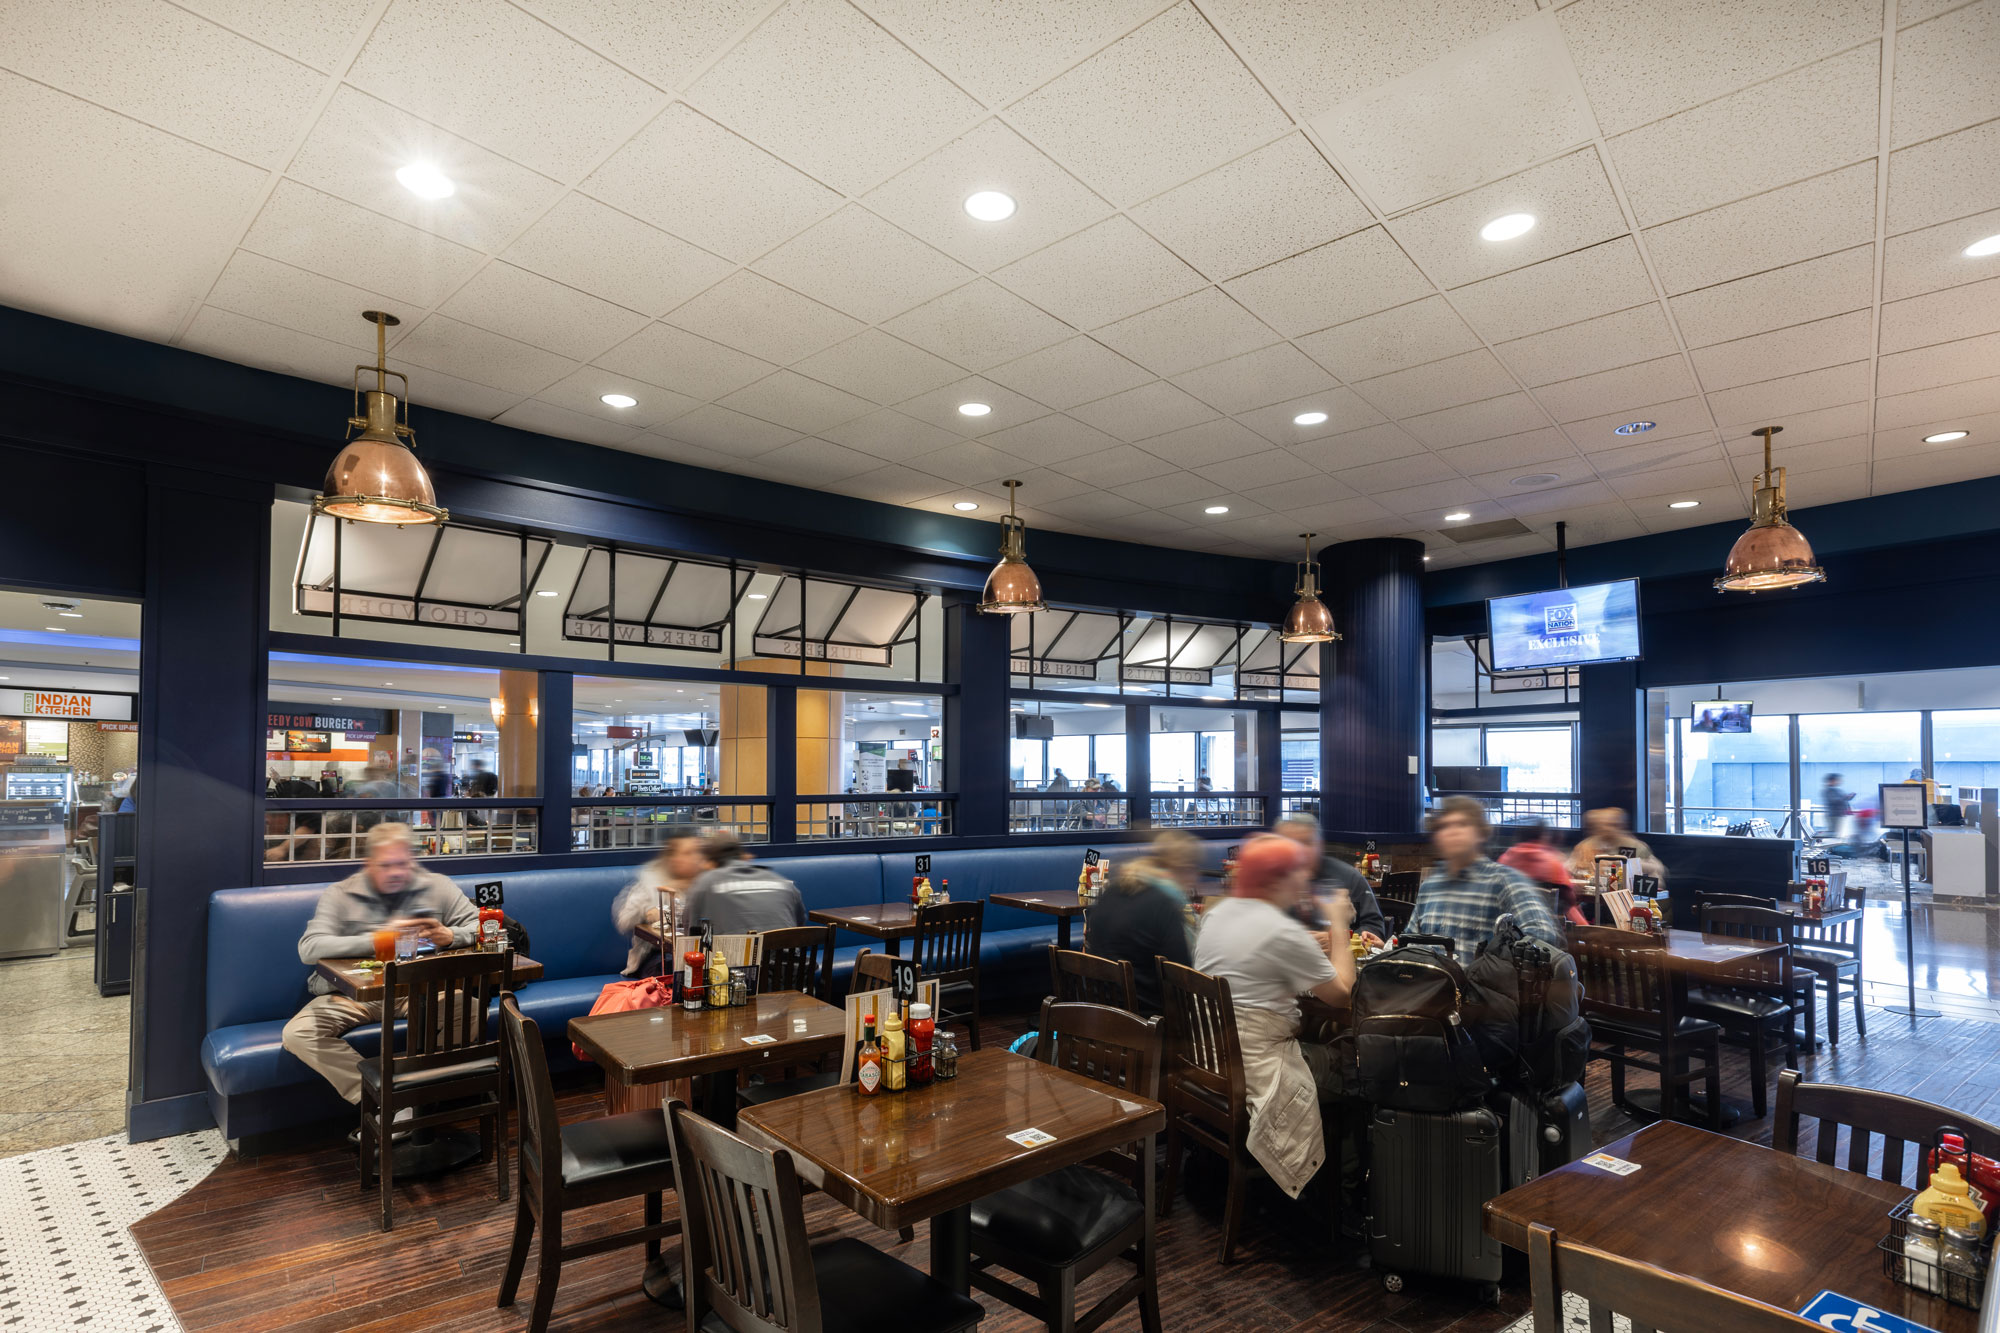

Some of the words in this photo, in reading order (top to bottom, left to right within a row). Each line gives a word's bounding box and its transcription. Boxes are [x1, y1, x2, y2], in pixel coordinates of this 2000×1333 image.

[1547, 607, 1574, 621] FOX
[1548, 620, 1575, 628] NATION
[1528, 633, 1600, 650] EXCLUSIVE
[293, 716, 313, 728] COW
[315, 717, 353, 730] BURGER
[1366, 841, 1375, 850] 28
[1087, 851, 1098, 864] 30
[1621, 849, 1634, 858] 27
[917, 857, 929, 871] 31
[1810, 860, 1827, 873] 16
[1637, 878, 1655, 893] 17
[479, 885, 500, 904] 33
[895, 965, 914, 995] 19
